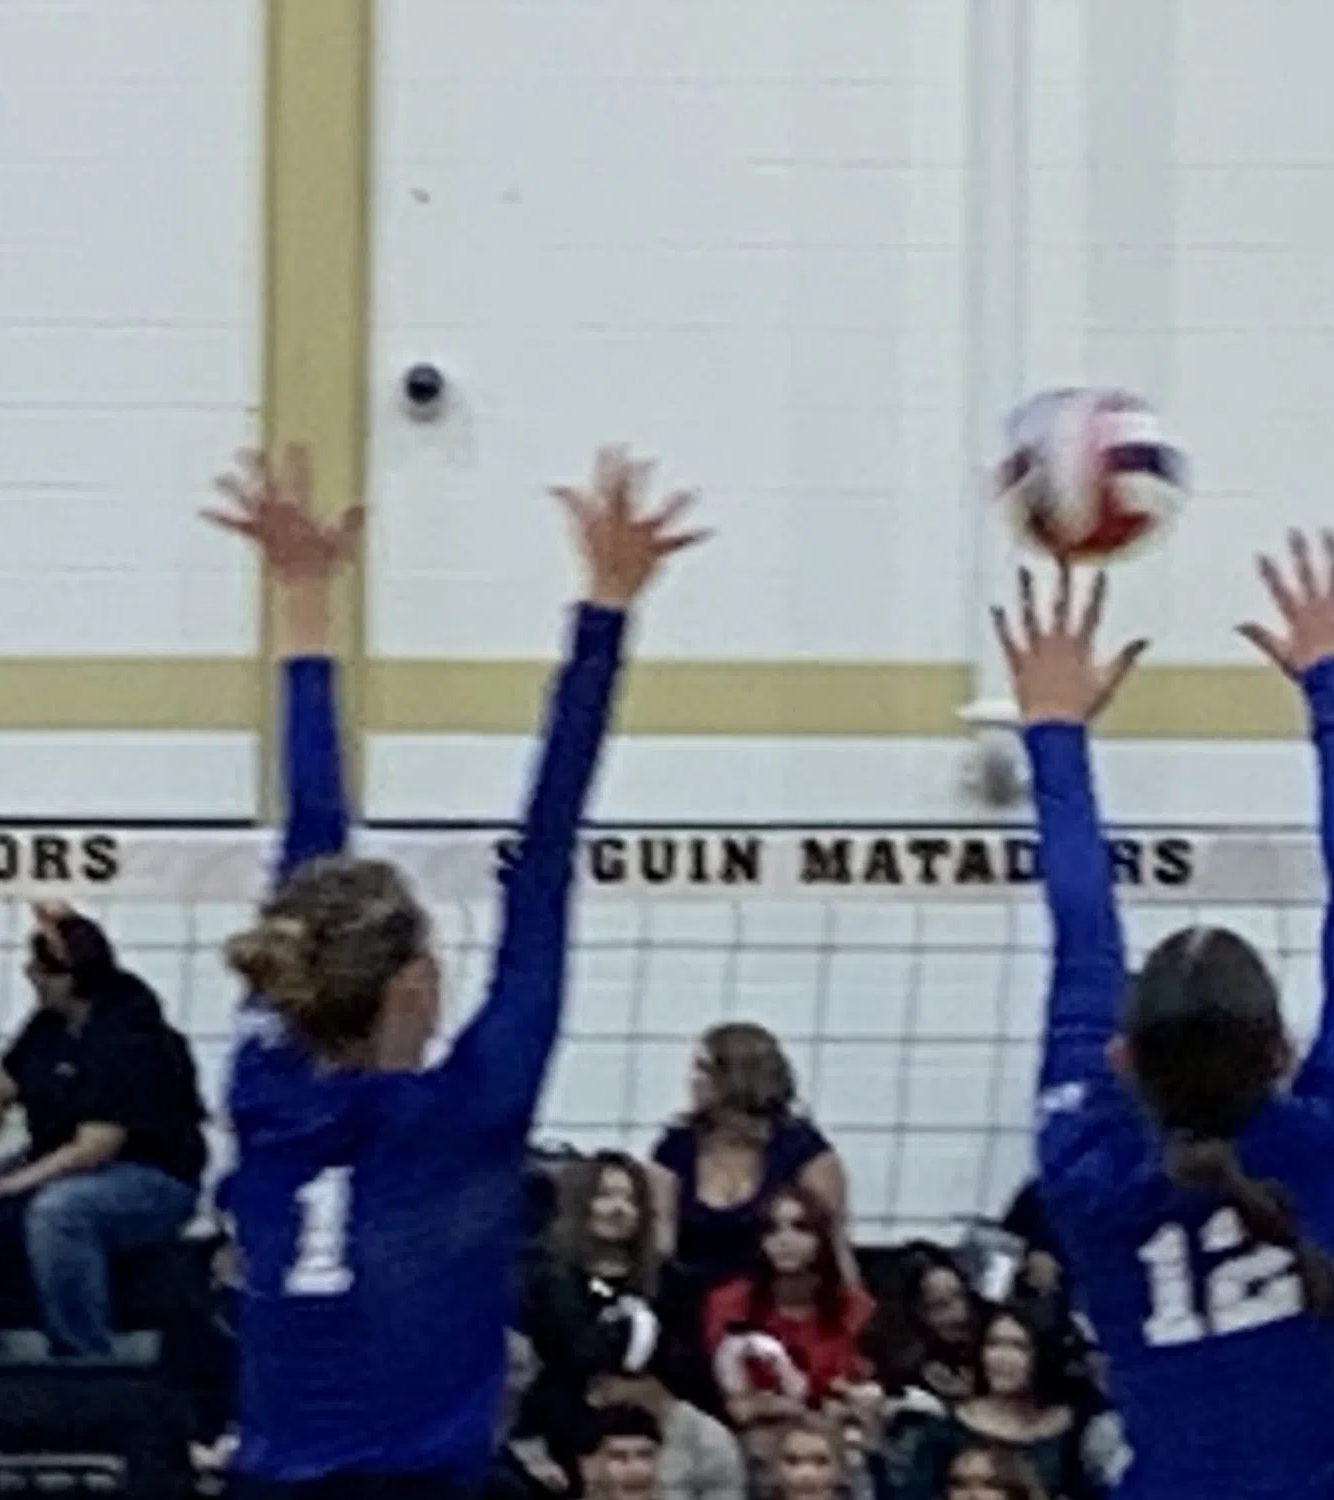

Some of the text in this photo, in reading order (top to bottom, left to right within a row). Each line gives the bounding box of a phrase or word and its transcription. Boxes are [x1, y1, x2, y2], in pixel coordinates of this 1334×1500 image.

[492, 837, 1194, 886] SGUIN MATADRS
[283, 1166, 355, 1296] 1
[1137, 1206, 1304, 1347] 12
